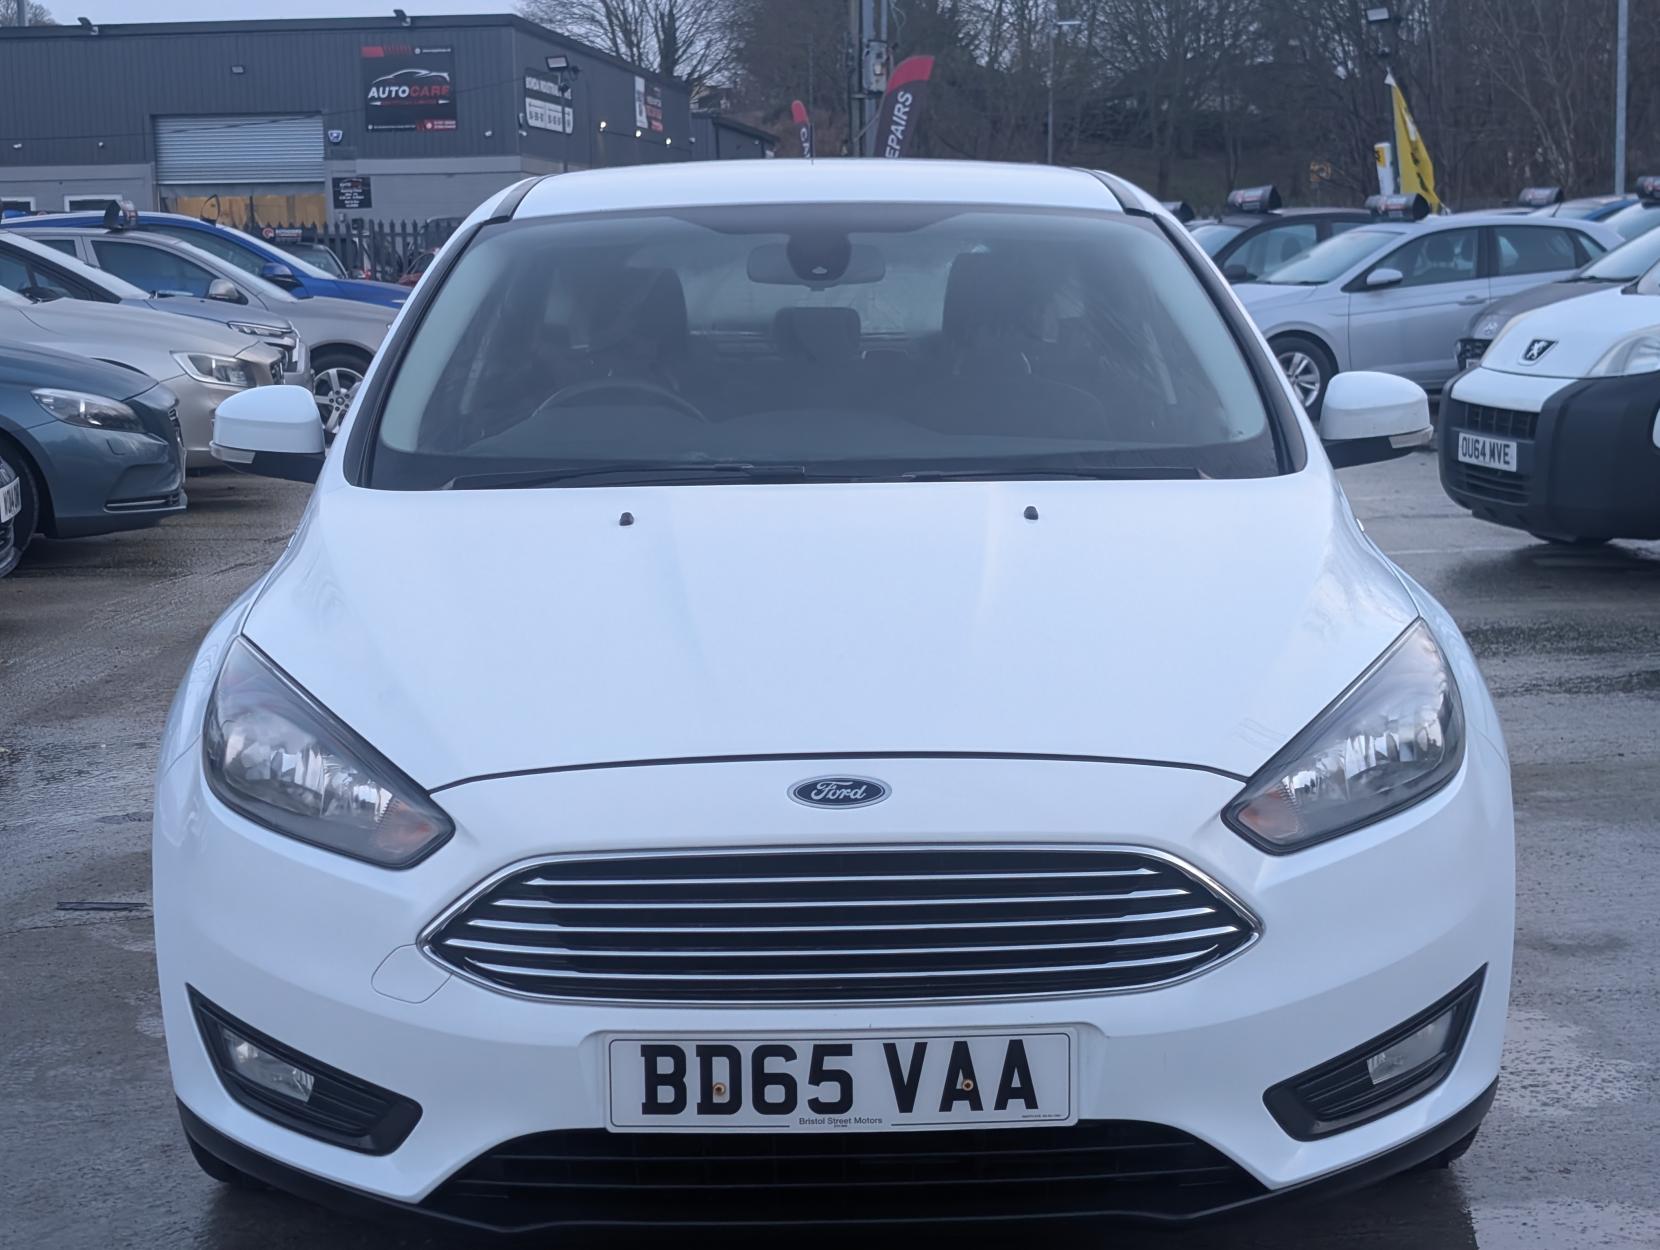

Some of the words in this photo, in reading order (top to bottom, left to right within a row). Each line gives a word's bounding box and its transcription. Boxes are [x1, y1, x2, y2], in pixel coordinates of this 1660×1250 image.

[811, 781, 868, 800] Ford
[640, 1043, 853, 1116] BD65
[882, 1039, 1039, 1114] VAA
[799, 1117, 825, 1125] Bristol
[827, 1117, 851, 1125] Street
[854, 1116, 883, 1124] Motors
